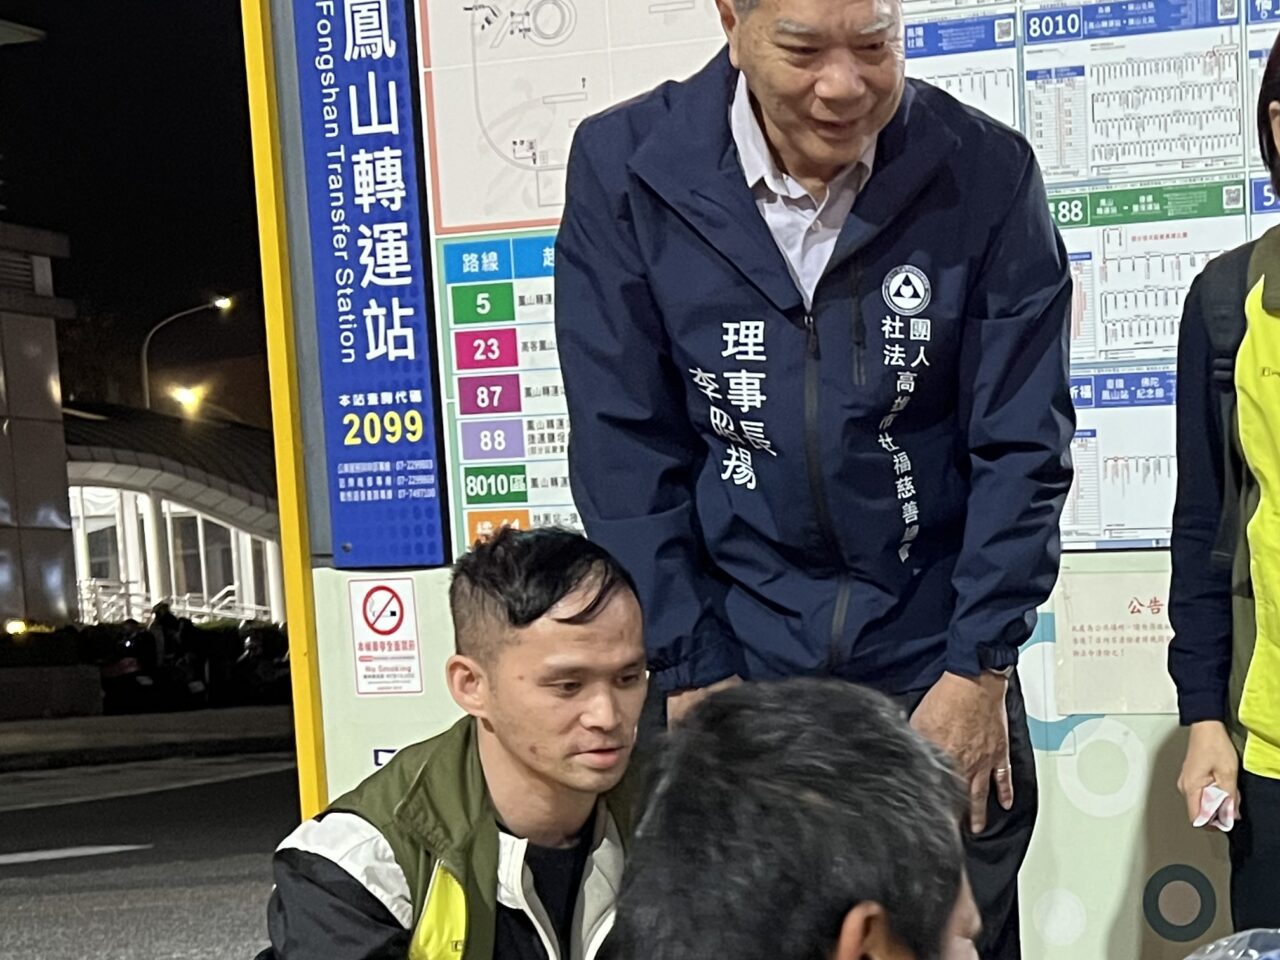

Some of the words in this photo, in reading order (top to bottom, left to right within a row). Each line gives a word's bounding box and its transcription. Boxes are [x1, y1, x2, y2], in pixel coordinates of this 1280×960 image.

[1028, 13, 1080, 38] 8010
[315, 1, 340, 138] Fongshan
[344, 0, 416, 362] 鳳山轉運站
[326, 144, 350, 260] Transfer
[462, 251, 499, 273] 路線
[335, 268, 358, 363] Station
[475, 293, 491, 315] 5
[473, 338, 500, 361] 23
[477, 386, 502, 408] 87
[720, 320, 777, 457] 理事長
[342, 409, 424, 446] 2099
[479, 429, 506, 451] 88
[1128, 596, 1164, 614] 公告
